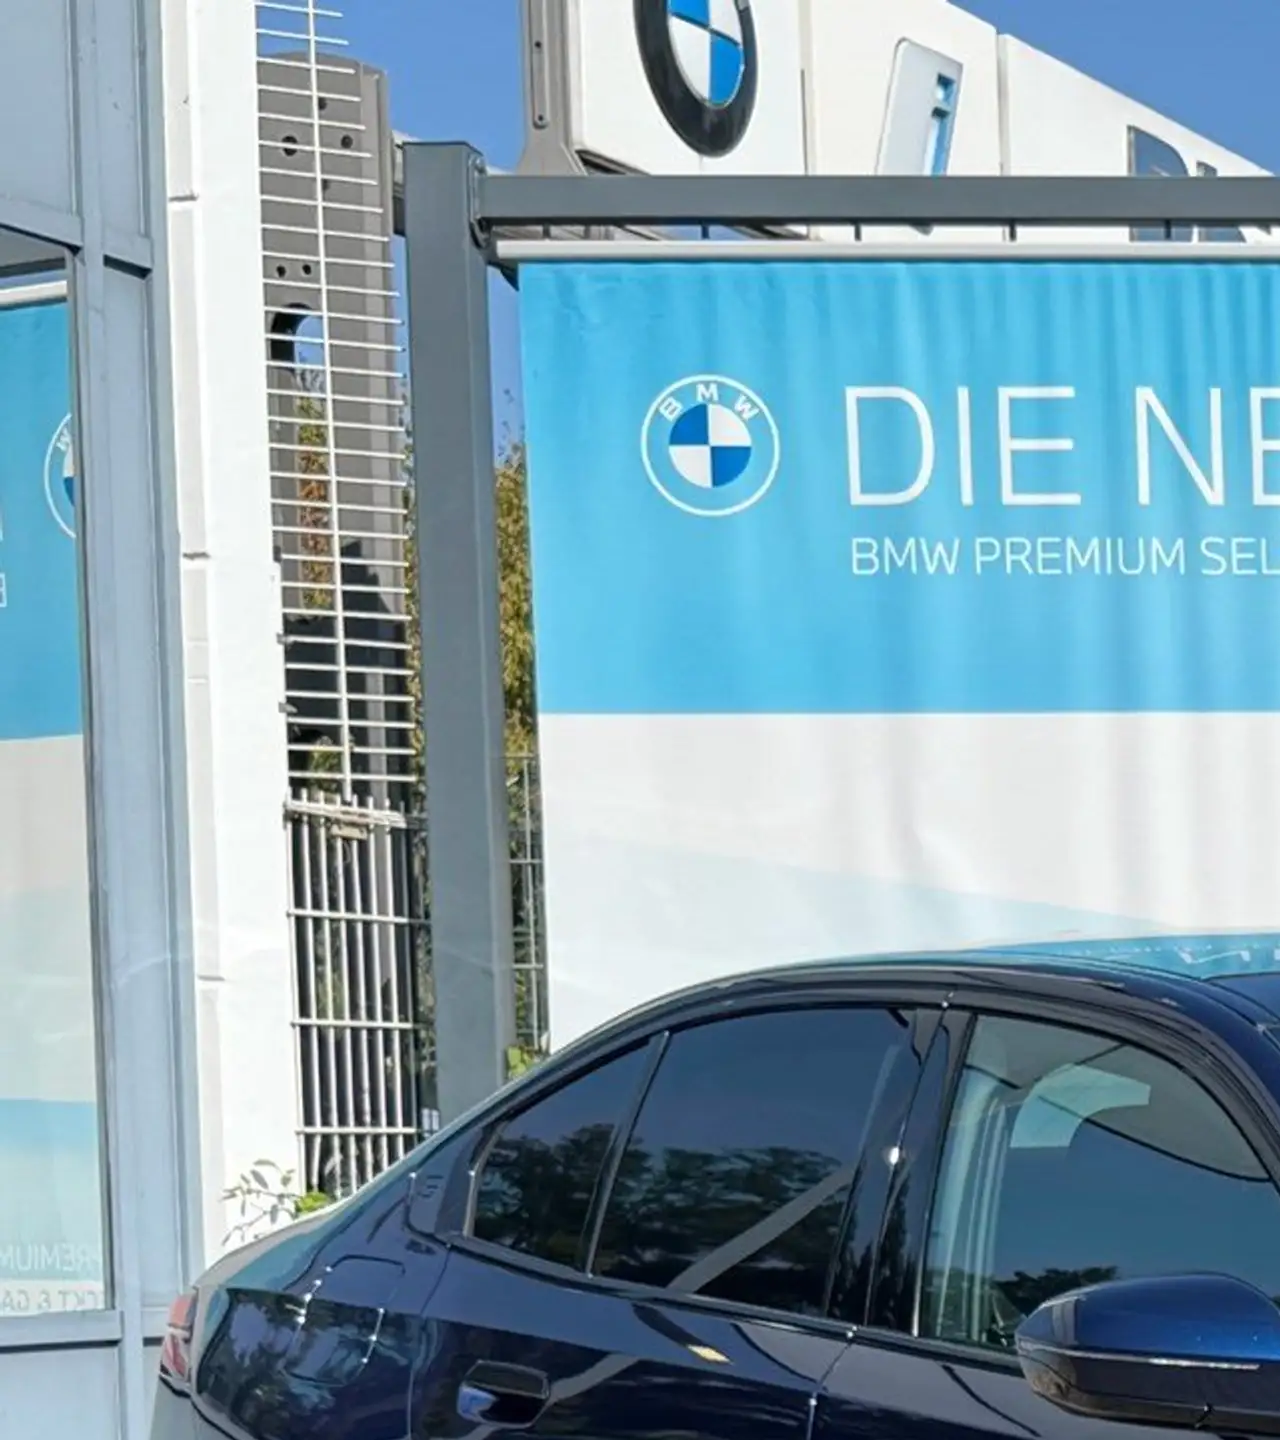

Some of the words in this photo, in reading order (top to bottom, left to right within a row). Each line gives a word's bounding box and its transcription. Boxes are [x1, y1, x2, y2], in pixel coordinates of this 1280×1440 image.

[658, 382, 760, 422] BMW
[843, 384, 1082, 508] DIE
[850, 536, 960, 576] BMW
[974, 536, 1187, 576] PREMIUM
